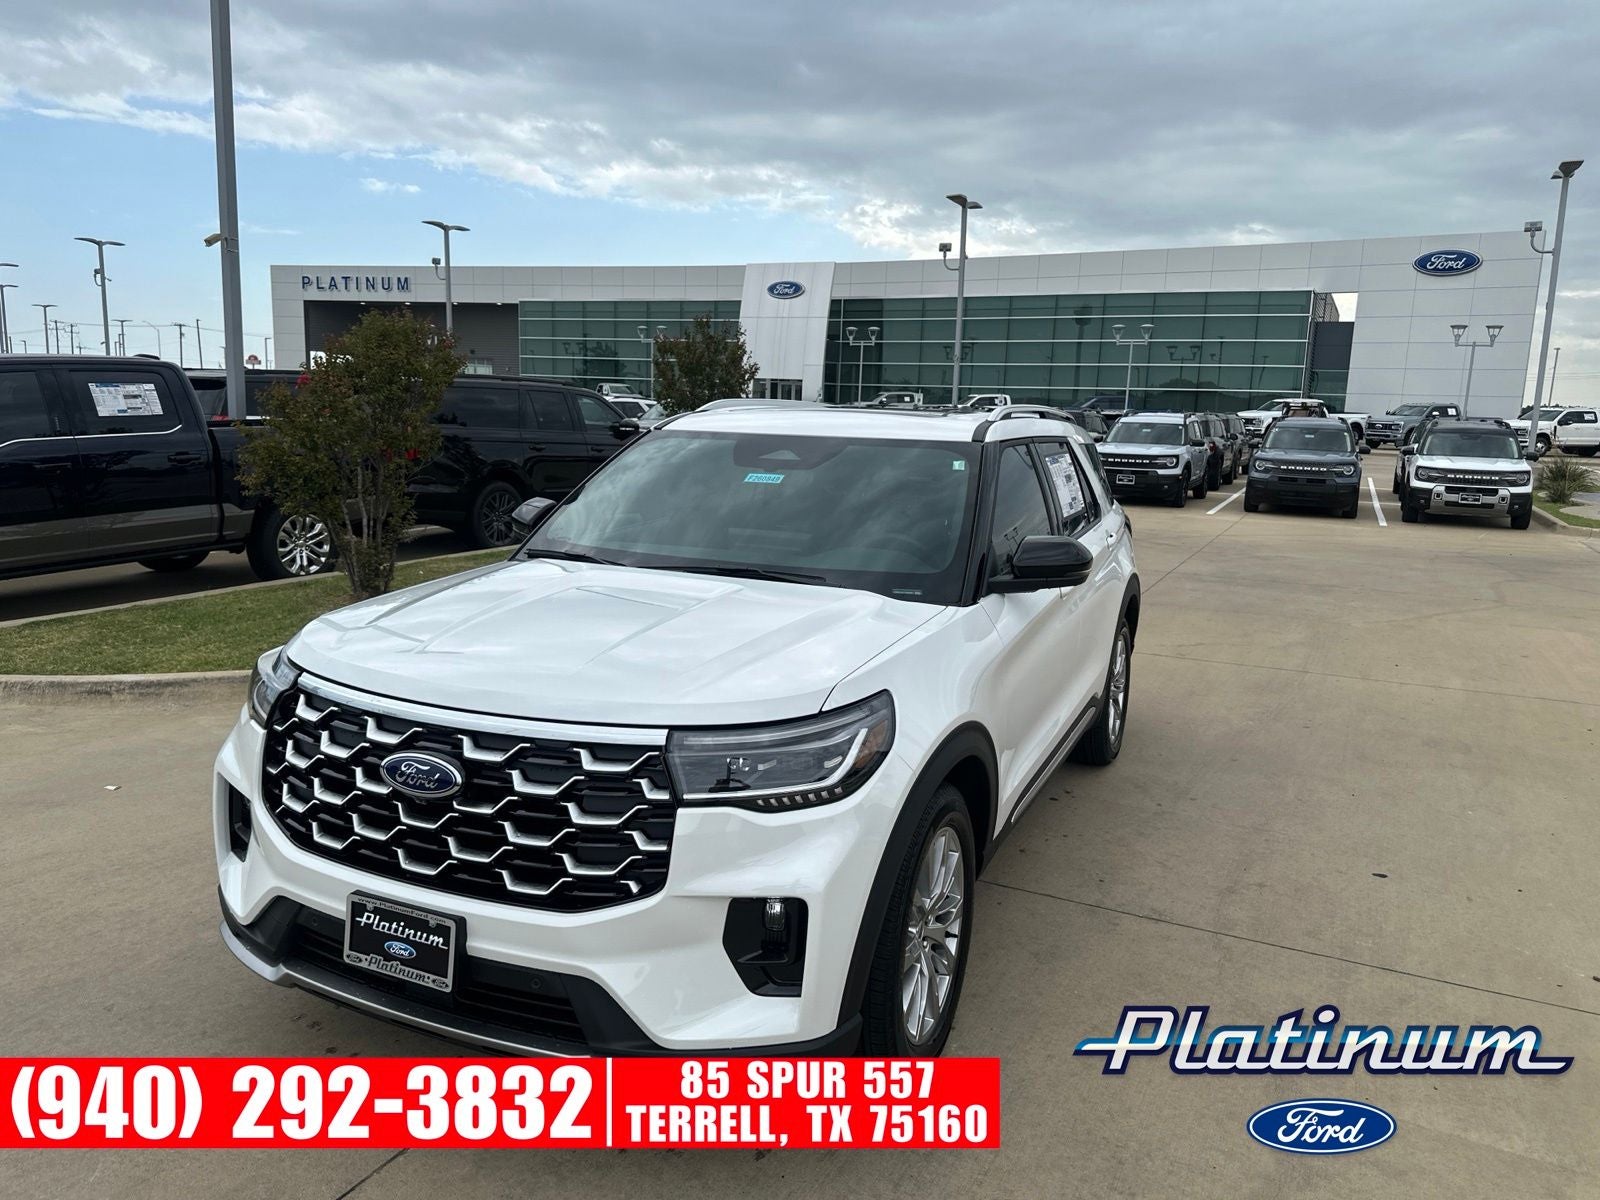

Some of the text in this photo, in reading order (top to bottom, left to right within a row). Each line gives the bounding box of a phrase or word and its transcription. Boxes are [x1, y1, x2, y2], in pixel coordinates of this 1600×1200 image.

[1426, 254, 1467, 269] Ford
[301, 276, 410, 291] PLATINUM
[395, 761, 440, 789] Ford
[355, 912, 448, 950] Platinum
[367, 955, 428, 983] Platinum
